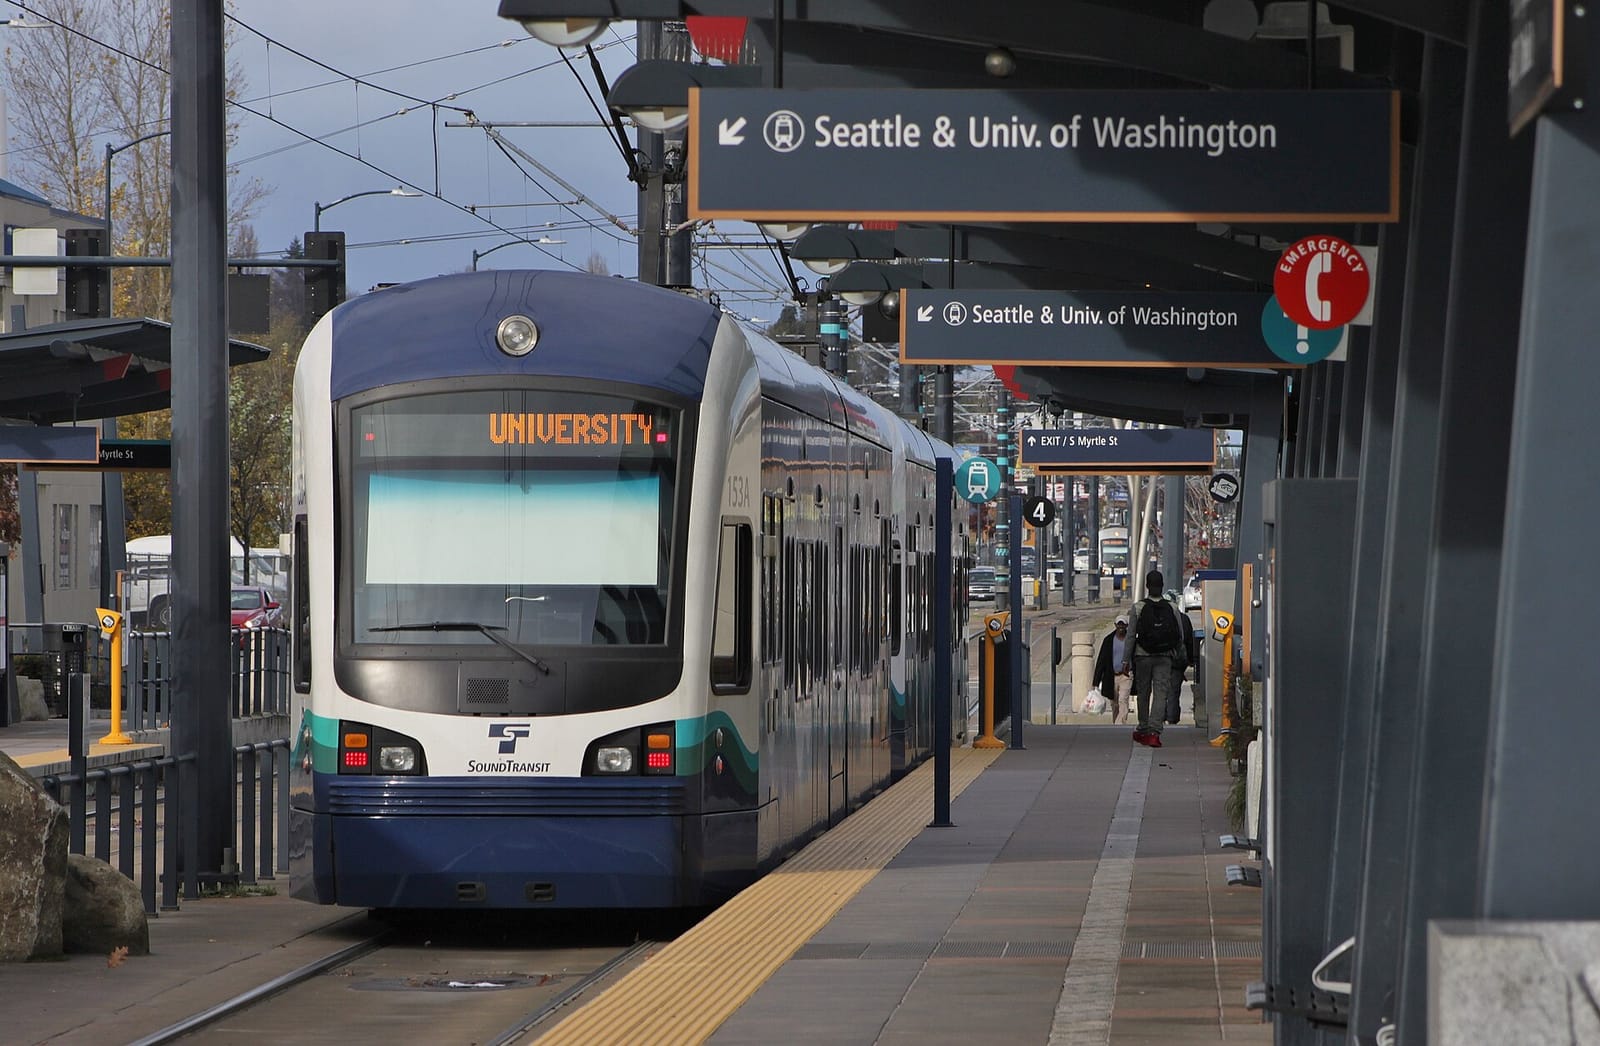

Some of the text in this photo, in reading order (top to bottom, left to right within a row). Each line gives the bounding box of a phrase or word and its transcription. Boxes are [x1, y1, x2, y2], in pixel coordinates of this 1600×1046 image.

[815, 114, 1277, 157] Seattle & Univ. of Washington
[1280, 239, 1363, 273] EMERGENCY
[972, 304, 1237, 331] Seattle & Univ. of Washington
[490, 413, 652, 444] UNIVERSITY
[1041, 436, 1060, 446] EXIT
[1069, 436, 1075, 446] S
[1077, 435, 1107, 448] Myrtle
[1109, 435, 1118, 446] St
[125, 449, 134, 459] St
[727, 475, 750, 507] 153A
[1032, 501, 1046, 521] 4
